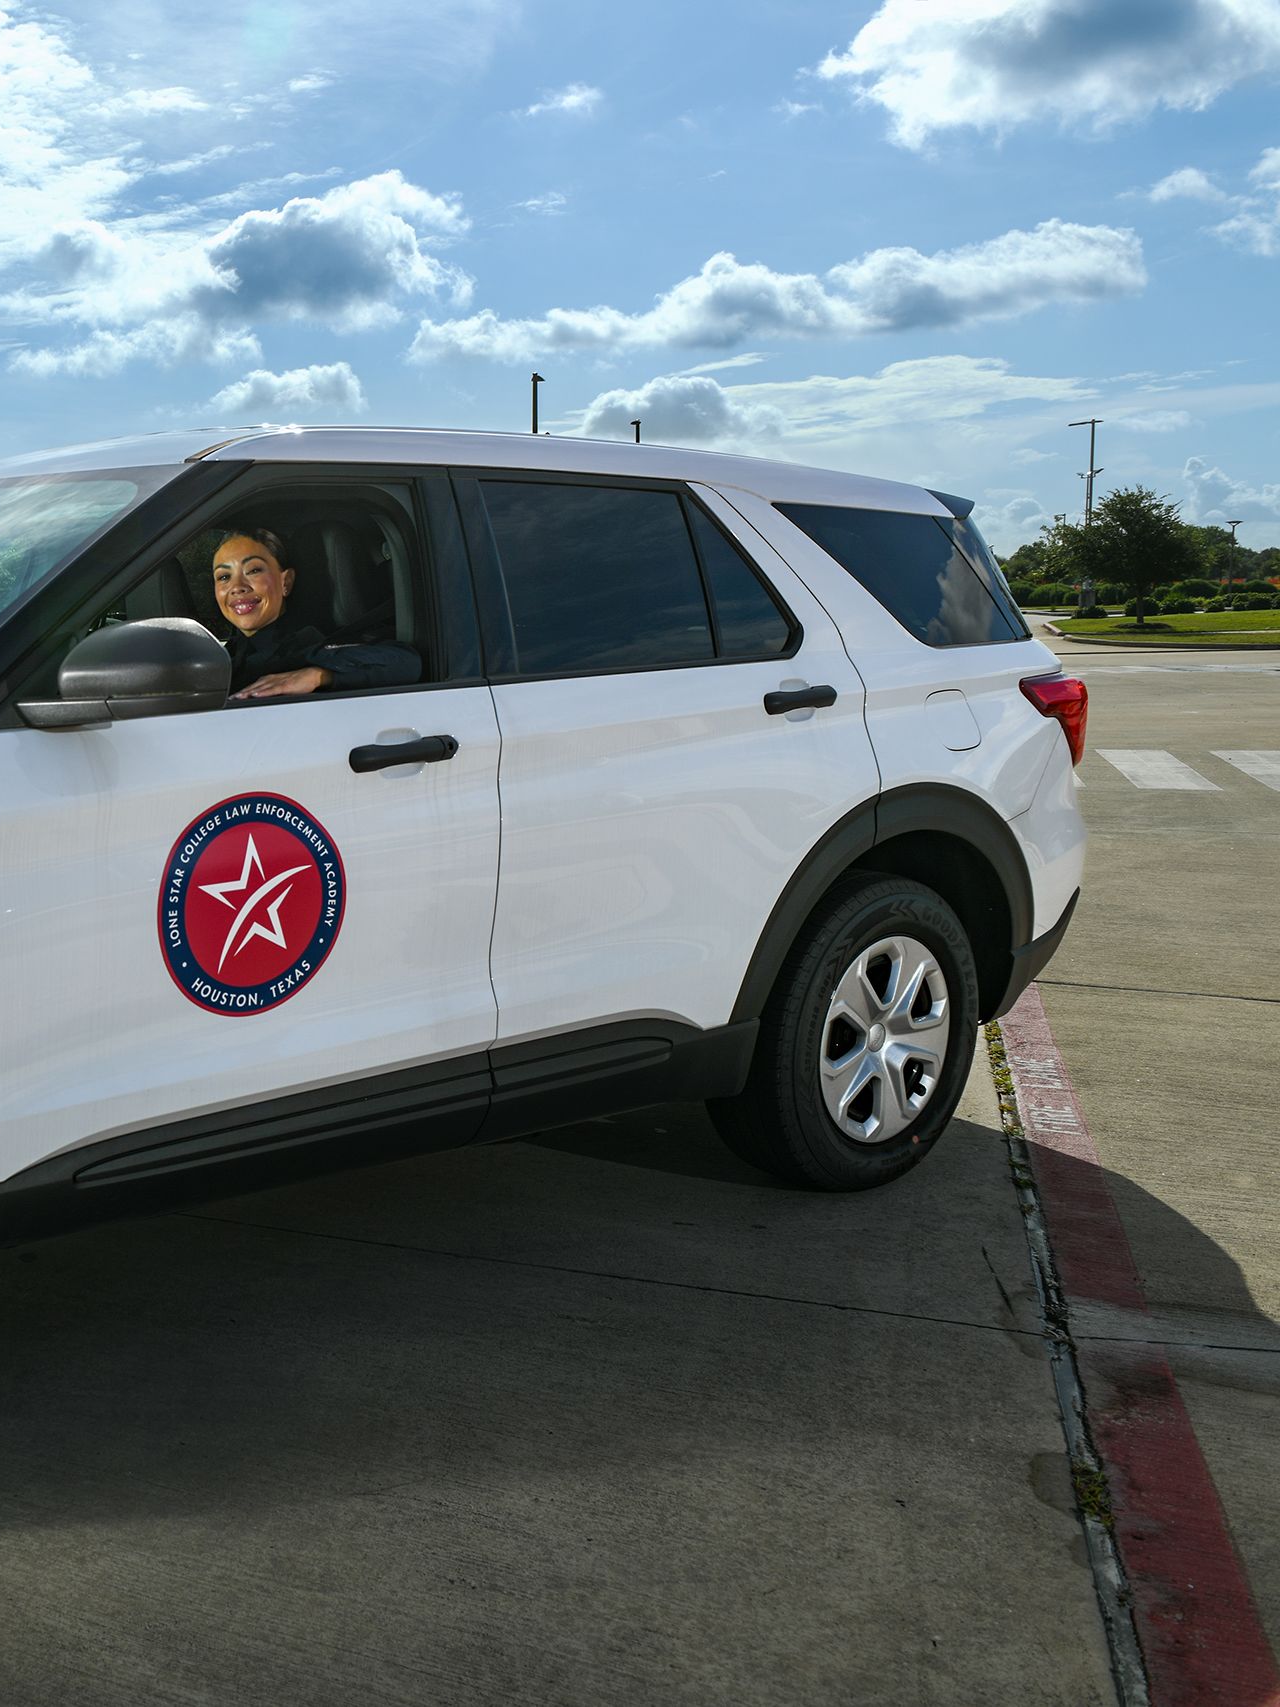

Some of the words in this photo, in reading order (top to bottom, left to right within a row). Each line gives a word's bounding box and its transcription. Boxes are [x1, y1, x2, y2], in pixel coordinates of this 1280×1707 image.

[225, 803, 252, 820] LAW
[255, 803, 329, 858] ENFORCEMENT
[180, 815, 222, 864] COLLEGE
[169, 869, 185, 904] STAR
[323, 862, 337, 927] ACADEMY
[168, 910, 182, 948] LONE
[191, 977, 265, 1008] HOUSTON,
[269, 960, 312, 998] TEXAS
[1012, 1055, 1065, 1090] LANE
[1027, 1104, 1083, 1136] FIRE
